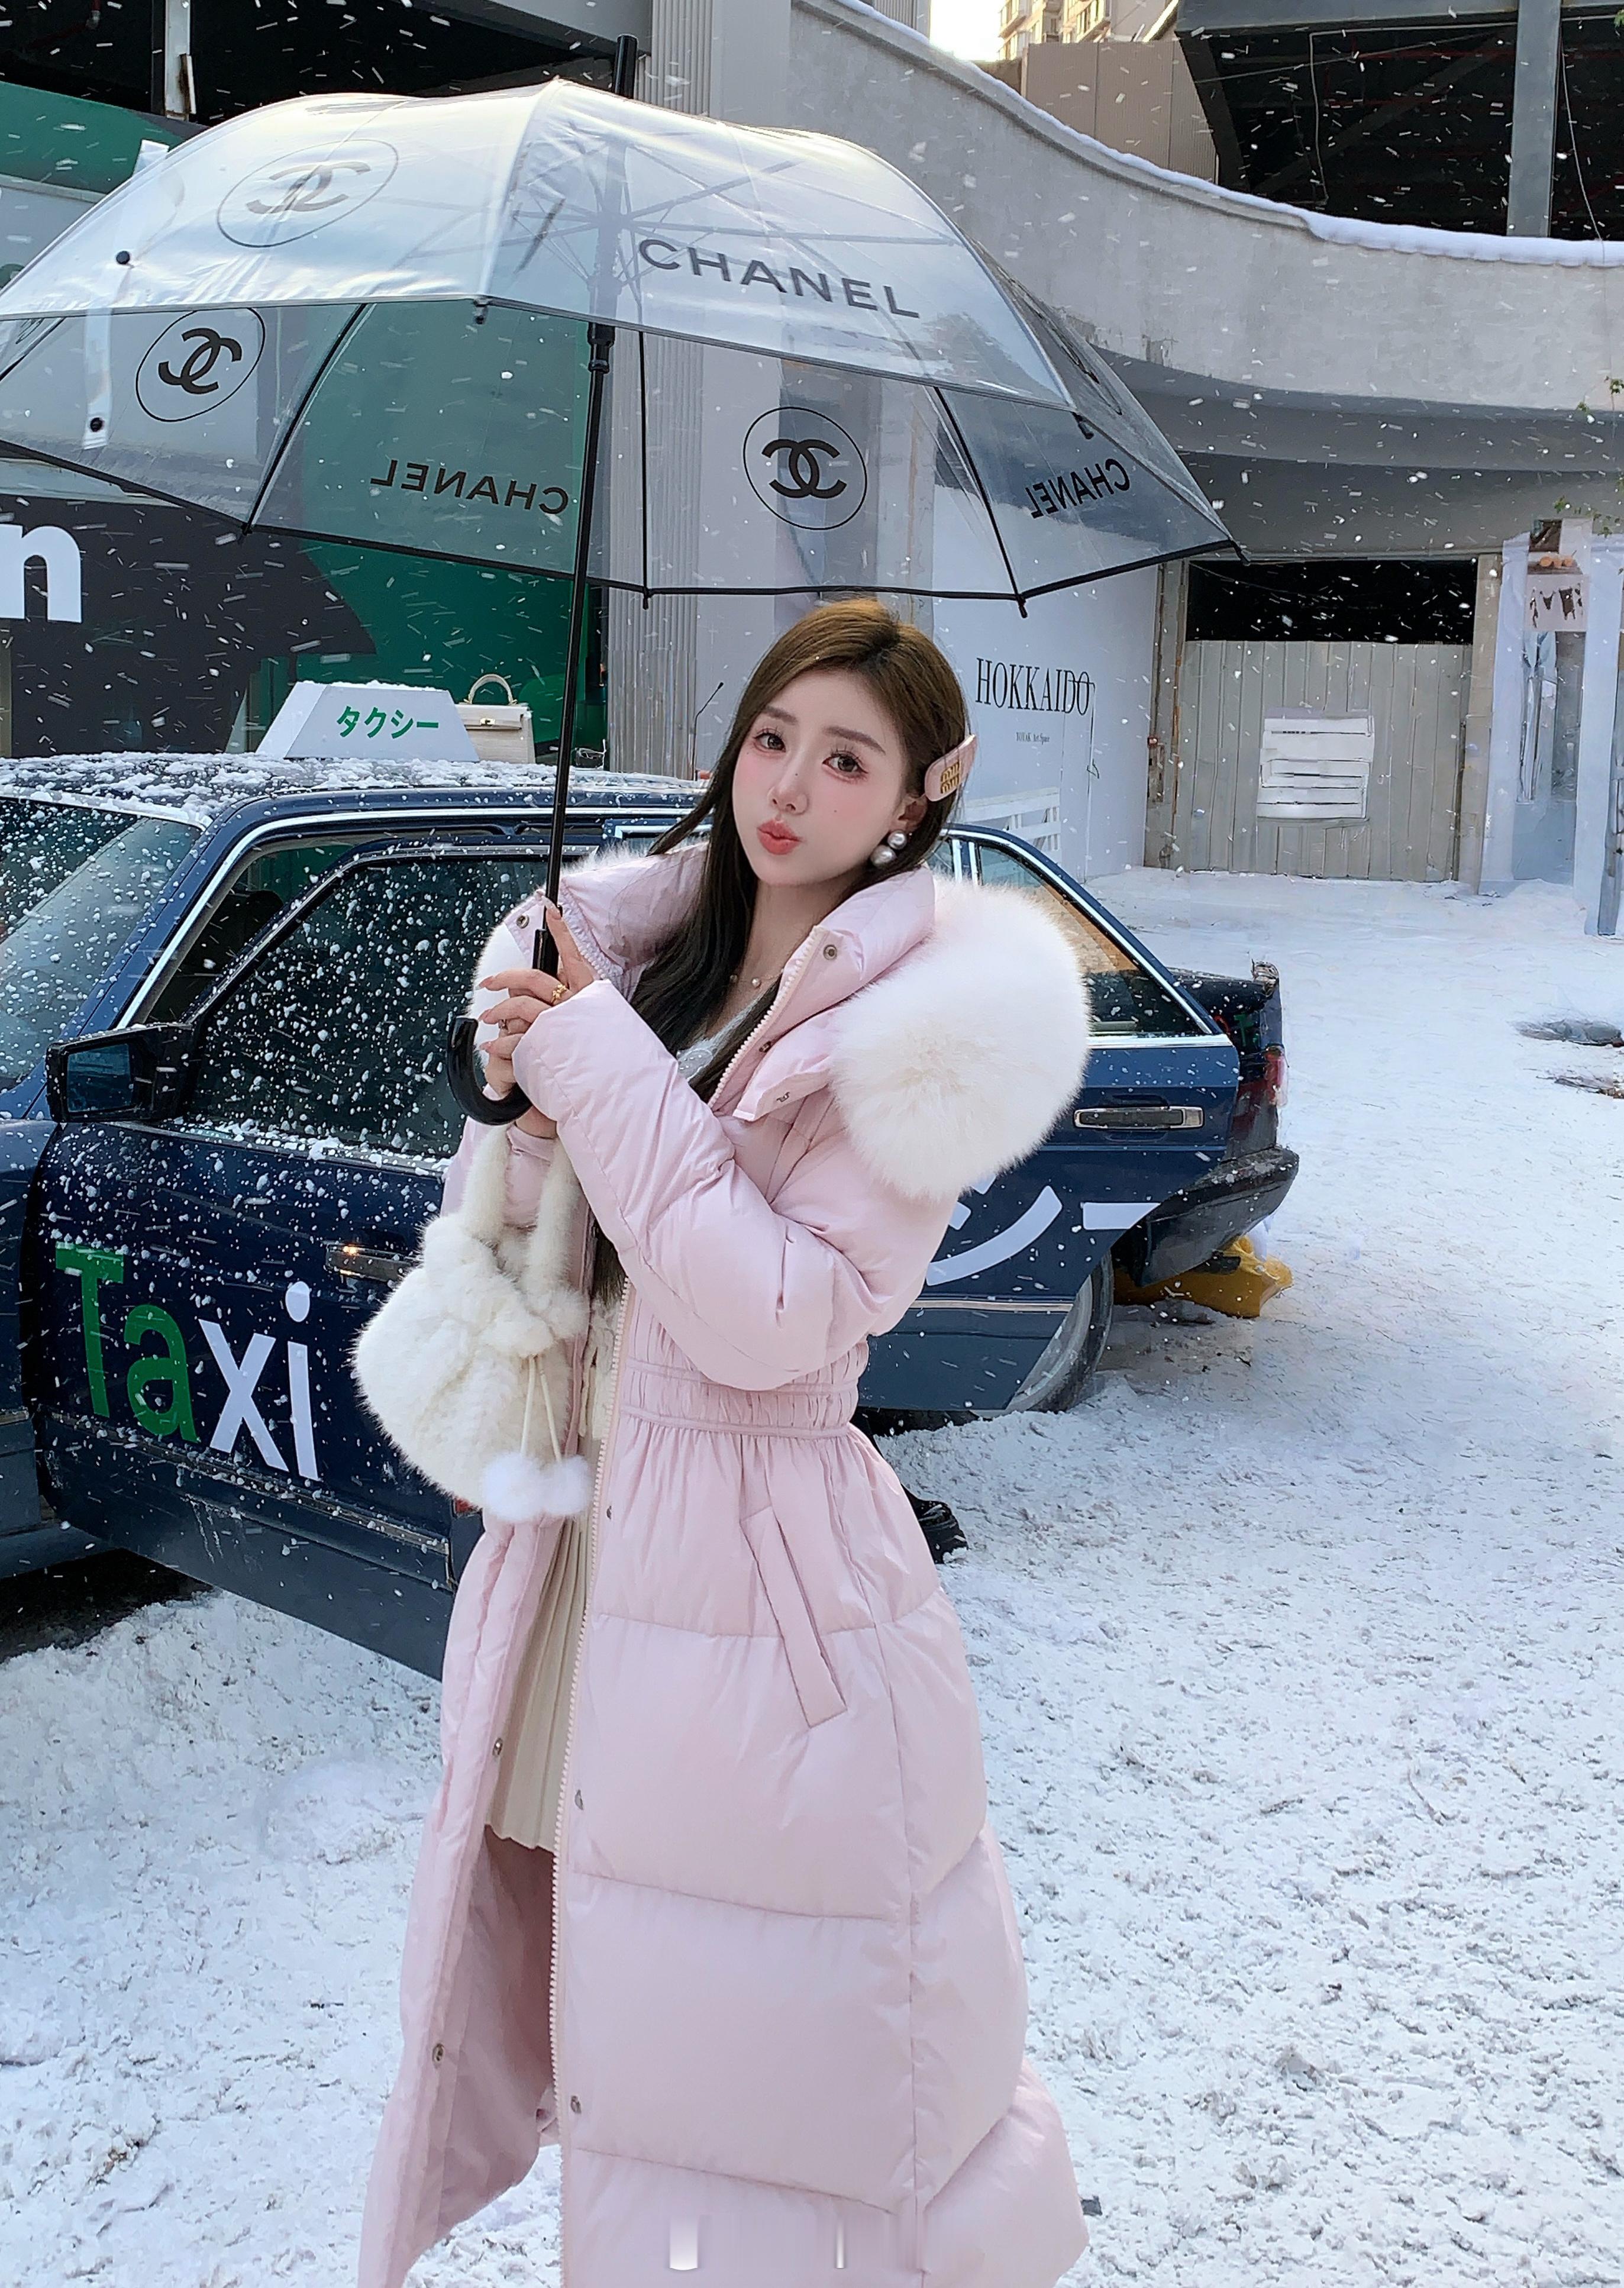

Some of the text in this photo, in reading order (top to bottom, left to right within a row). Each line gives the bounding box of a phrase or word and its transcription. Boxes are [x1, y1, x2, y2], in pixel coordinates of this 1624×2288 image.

[639, 238, 919, 318] CHANEL
[976, 658, 1090, 715] HOKKAIDO
[337, 705, 439, 738] タクシー
[55, 1242, 319, 1482] Taxi
